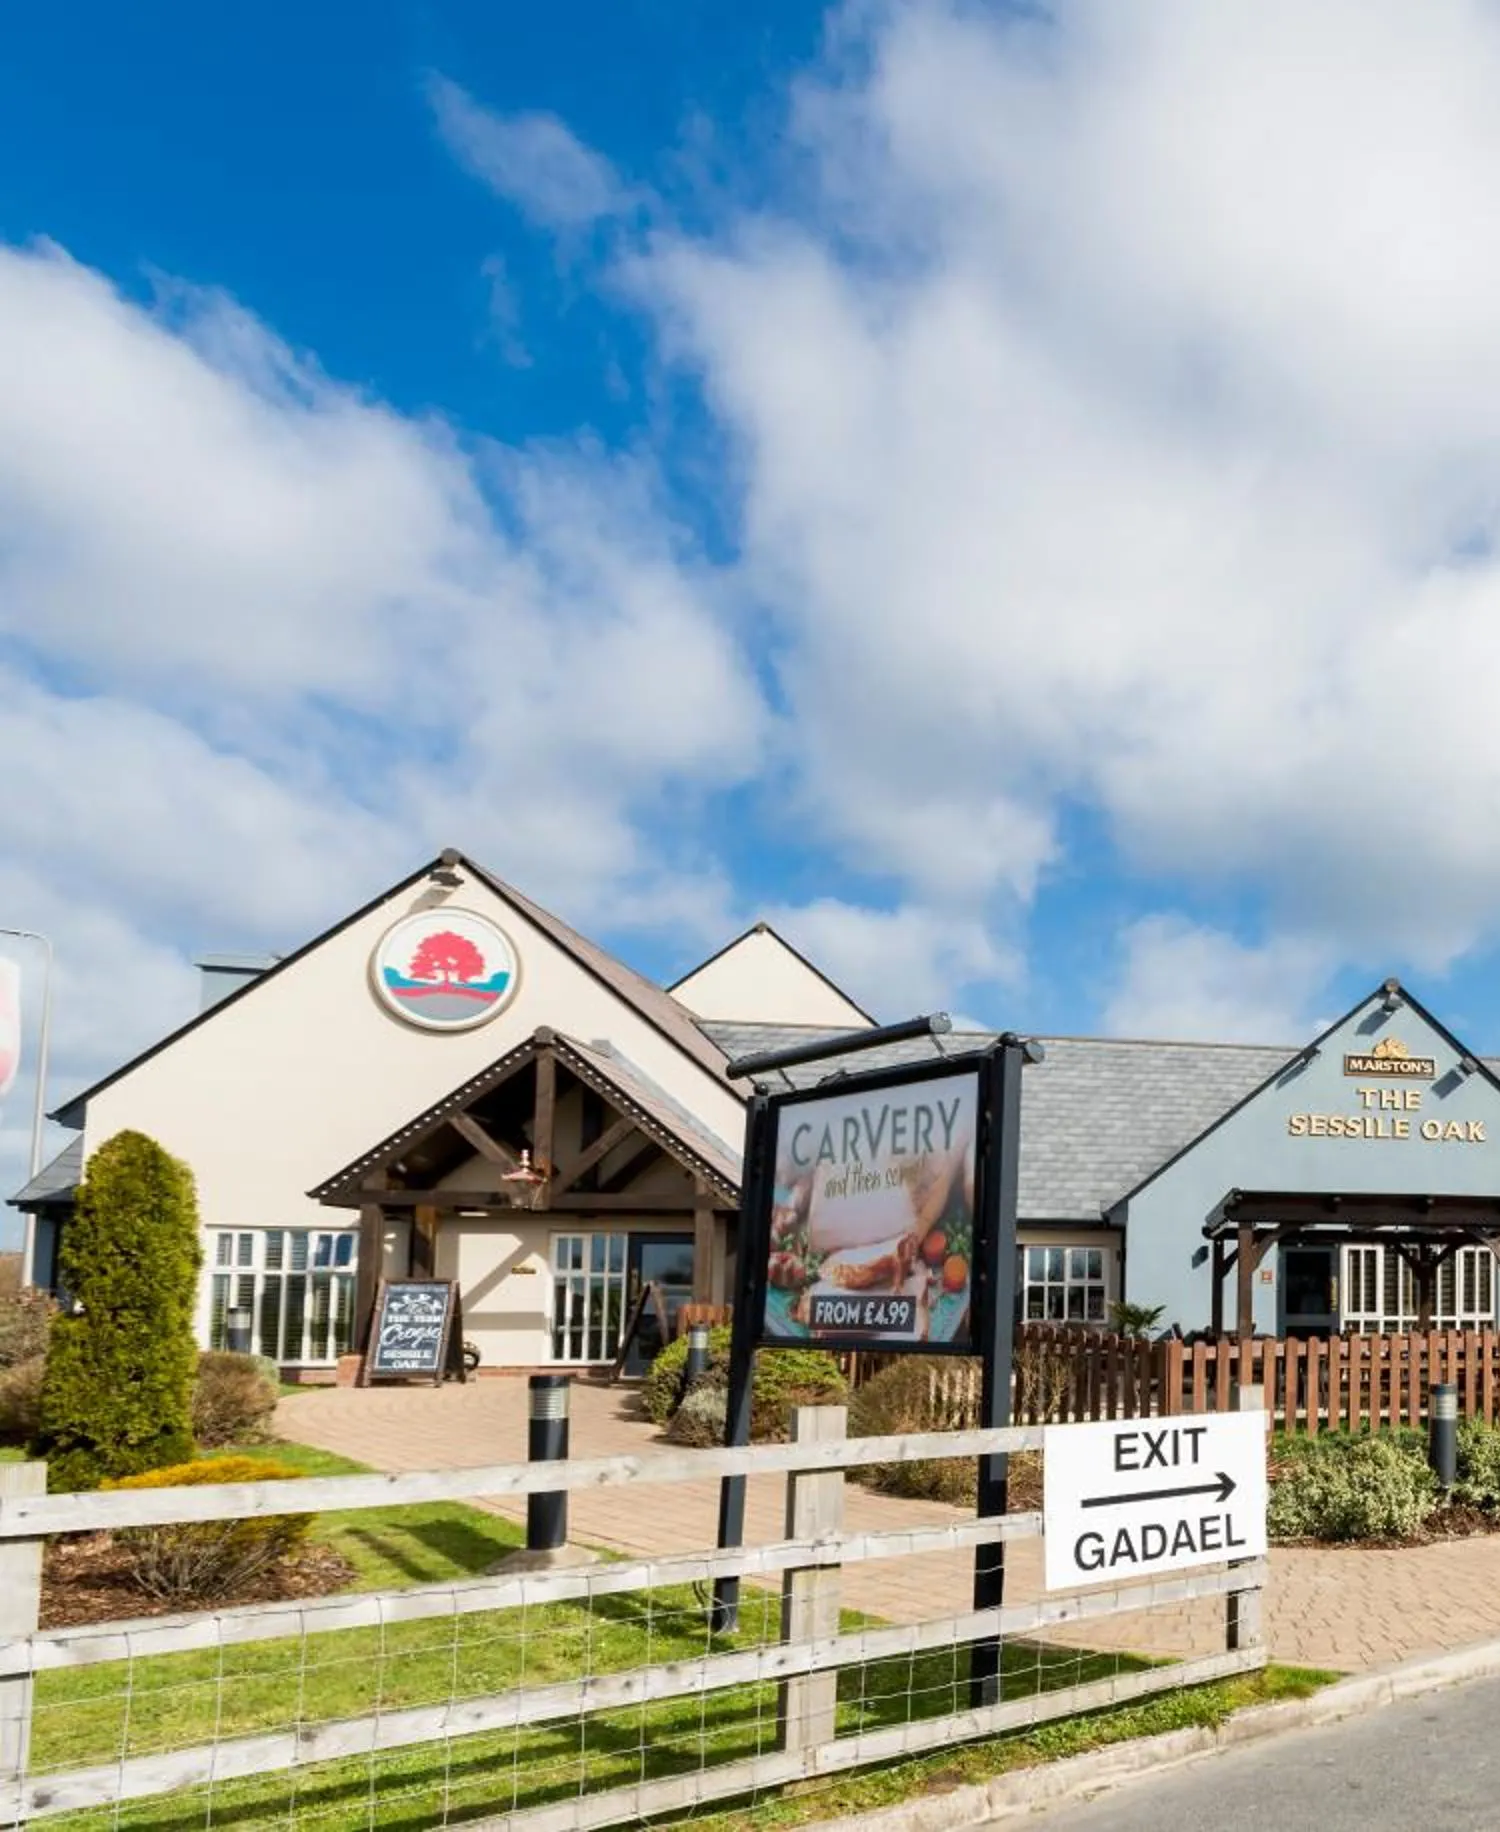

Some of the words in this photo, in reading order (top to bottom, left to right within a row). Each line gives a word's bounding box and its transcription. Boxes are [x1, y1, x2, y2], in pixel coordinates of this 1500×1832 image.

[1349, 1058, 1433, 1075] MARSTON'S
[1358, 1087, 1422, 1111] THE
[790, 1097, 961, 1167] CARVERY
[1288, 1113, 1410, 1139] SESSILE
[1421, 1119, 1487, 1142] OAK
[815, 1302, 859, 1325] FROM
[864, 1301, 910, 1326] £4.99
[391, 1360, 420, 1369] OAK
[1114, 1427, 1208, 1472] EXIT
[1074, 1513, 1247, 1571] GADAEL
